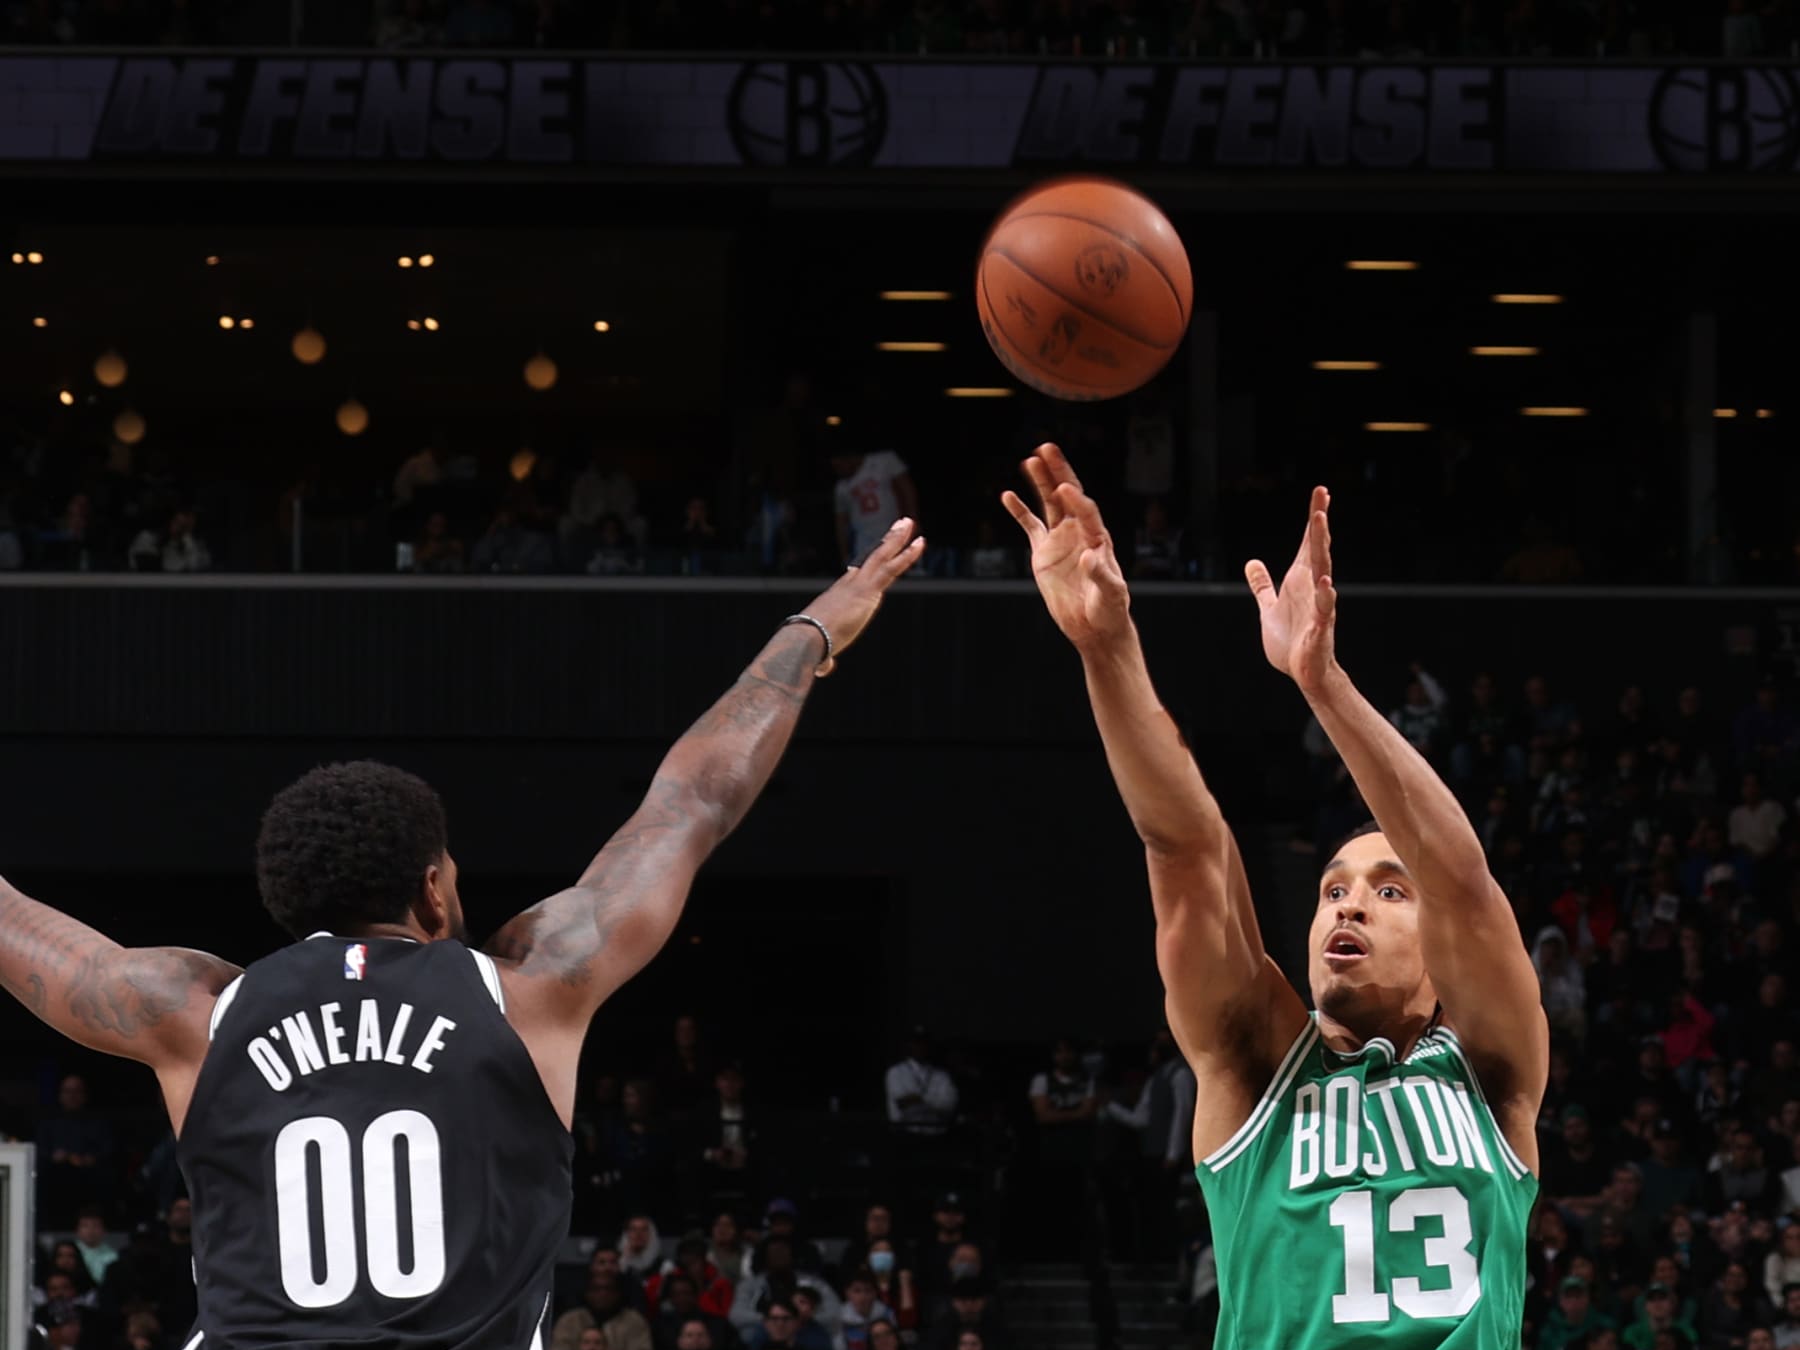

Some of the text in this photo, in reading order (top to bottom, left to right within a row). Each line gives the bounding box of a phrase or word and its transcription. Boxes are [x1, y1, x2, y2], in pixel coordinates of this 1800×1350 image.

[247, 998, 457, 1093] O'NEALE
[1288, 1076, 1494, 1190] BOSTON
[274, 1109, 447, 1309] 00
[1328, 1186, 1482, 1324] 13
